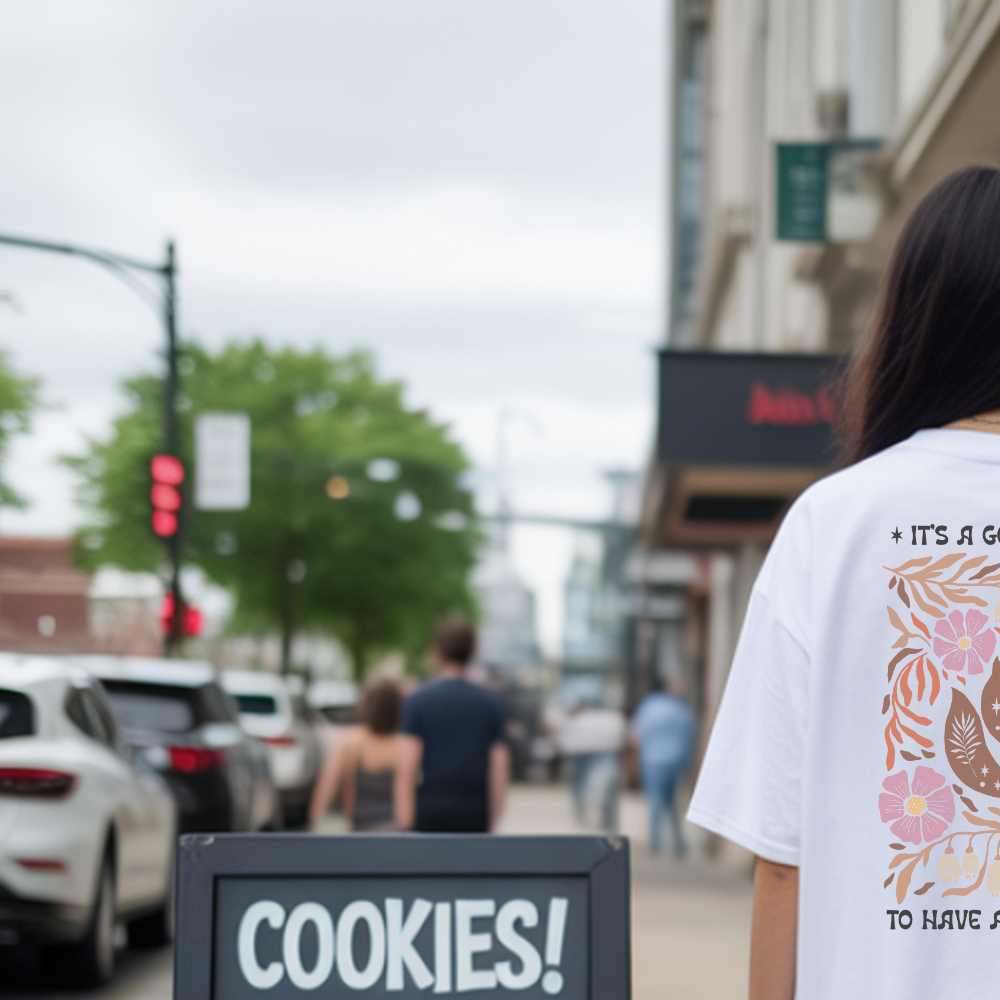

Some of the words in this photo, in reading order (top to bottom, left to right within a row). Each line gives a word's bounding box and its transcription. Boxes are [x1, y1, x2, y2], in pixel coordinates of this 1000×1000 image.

[911, 523, 949, 546] IT'S
[956, 525, 974, 546] A
[886, 909, 913, 930] TO
[921, 909, 982, 930] HAVE
[238, 898, 568, 994] COOKIES!
